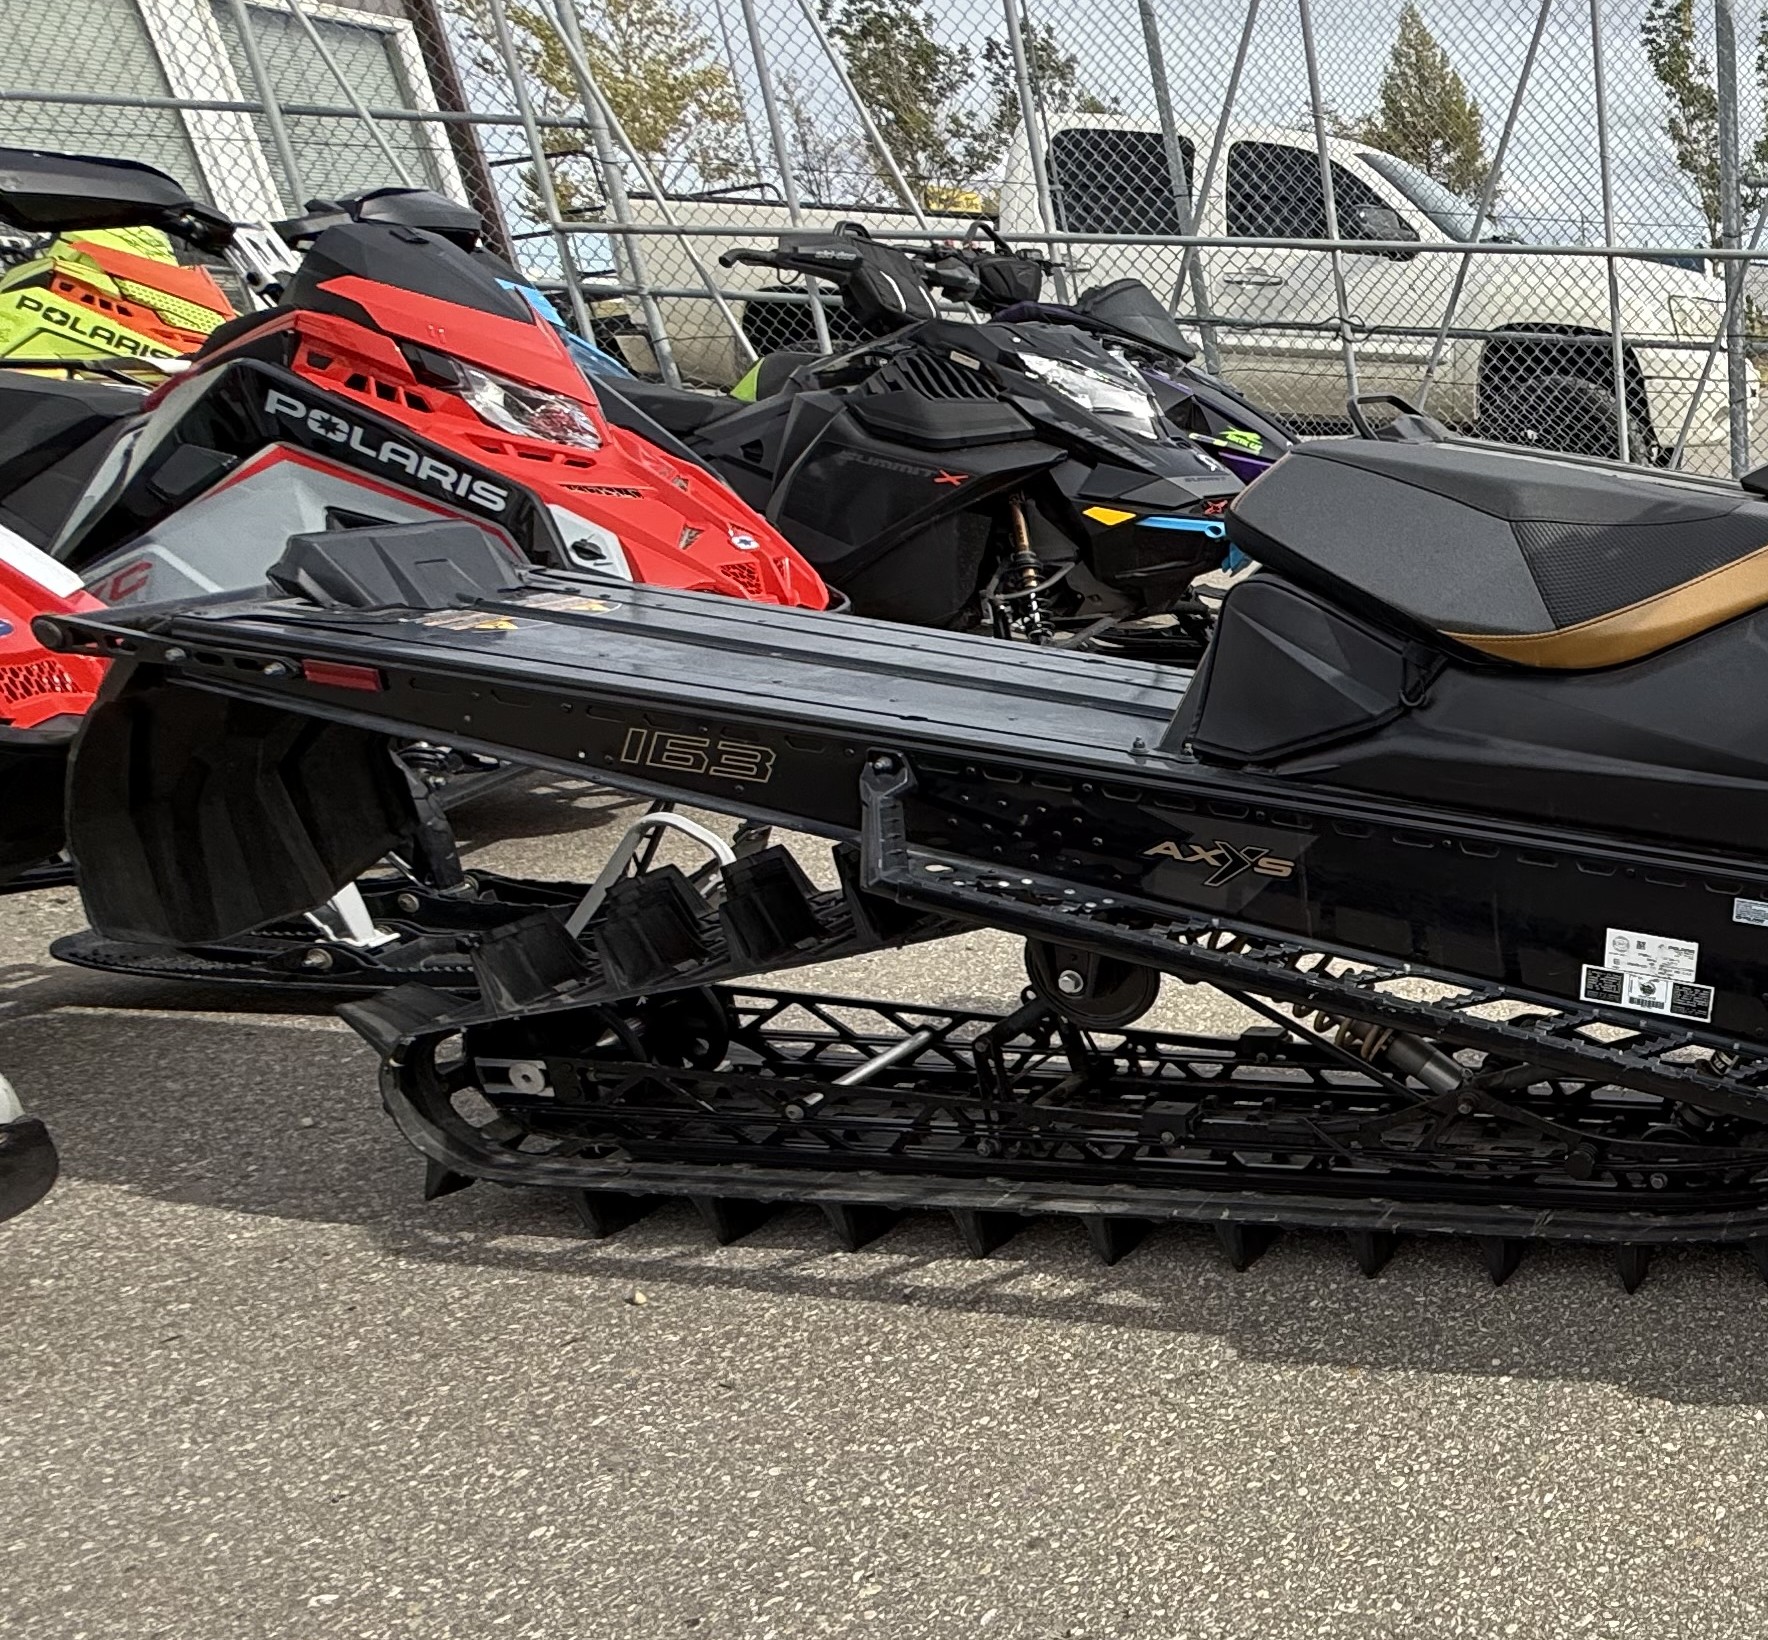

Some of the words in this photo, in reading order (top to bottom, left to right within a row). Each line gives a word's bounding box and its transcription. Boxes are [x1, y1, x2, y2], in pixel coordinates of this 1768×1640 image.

[264, 389, 508, 512] POLARIS
[620, 727, 777, 784] 163
[1143, 840, 1295, 887] AXYS
